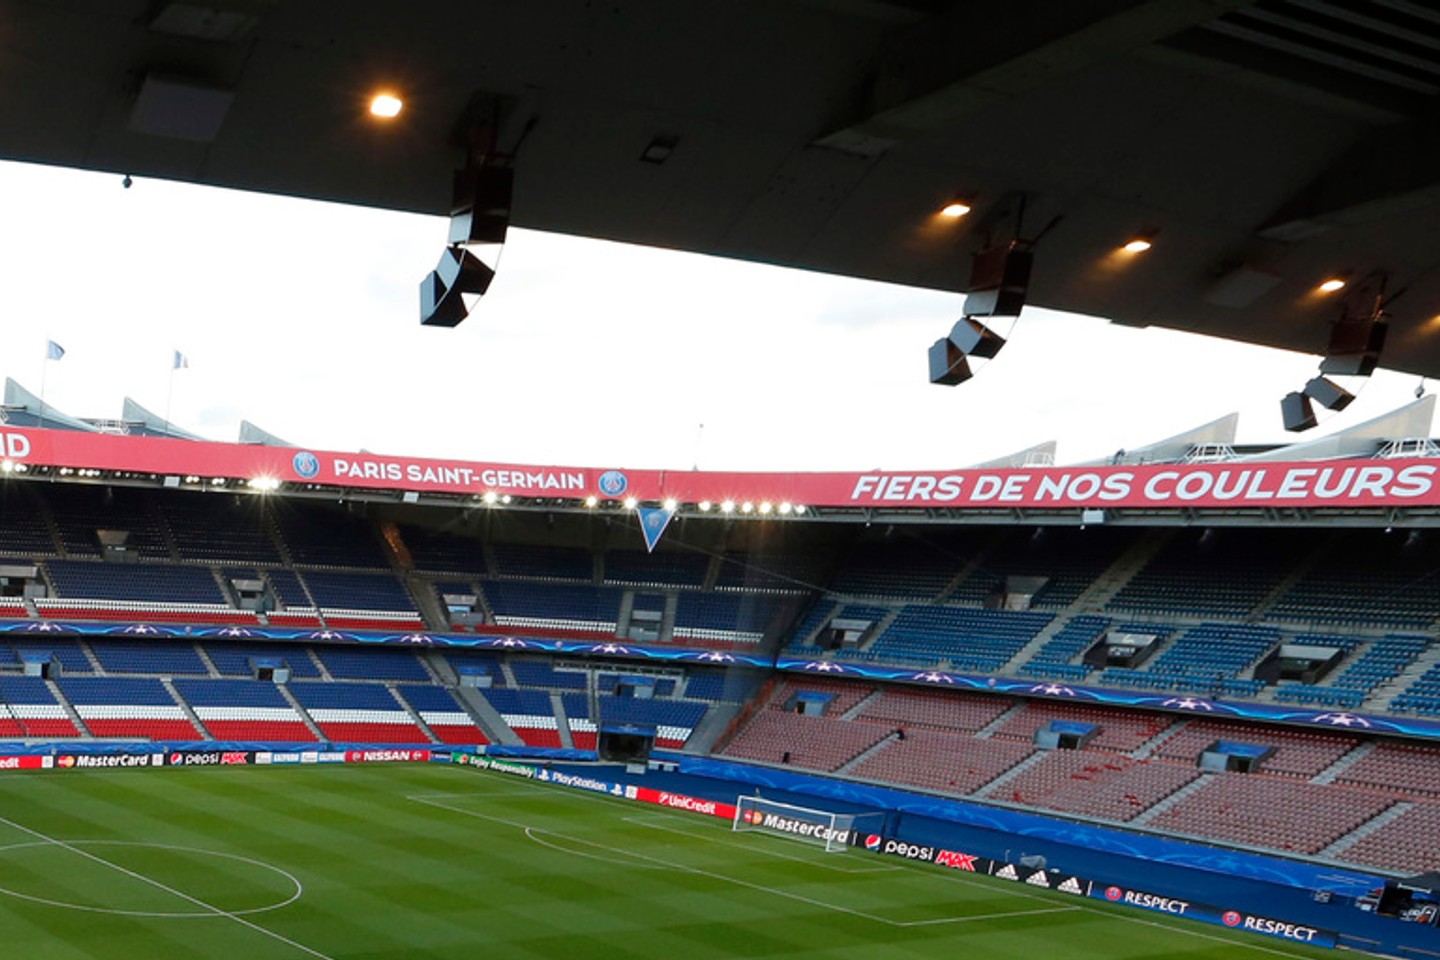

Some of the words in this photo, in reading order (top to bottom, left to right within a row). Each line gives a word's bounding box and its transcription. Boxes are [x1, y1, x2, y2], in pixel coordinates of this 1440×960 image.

[333, 459, 402, 480] PARIS
[407, 464, 585, 489] SAINT-GERMAIN
[851, 474, 962, 501] FIERS
[969, 474, 1030, 502] DE
[1036, 471, 1132, 501] NOS
[1143, 465, 1438, 500] COULEURS
[77, 755, 148, 768] MasterCard
[185, 752, 219, 765] pepsi
[363, 751, 410, 761] NISSAN
[469, 755, 489, 769] Enjoy
[490, 759, 534, 779] Responsibly
[551, 771, 608, 793] PlayStation
[668, 794, 716, 816] UniCredit
[764, 813, 849, 844] MasterCard
[884, 839, 934, 861] pepsi
[1124, 889, 1189, 915] RESPECT
[1244, 916, 1318, 941] RESPECT
